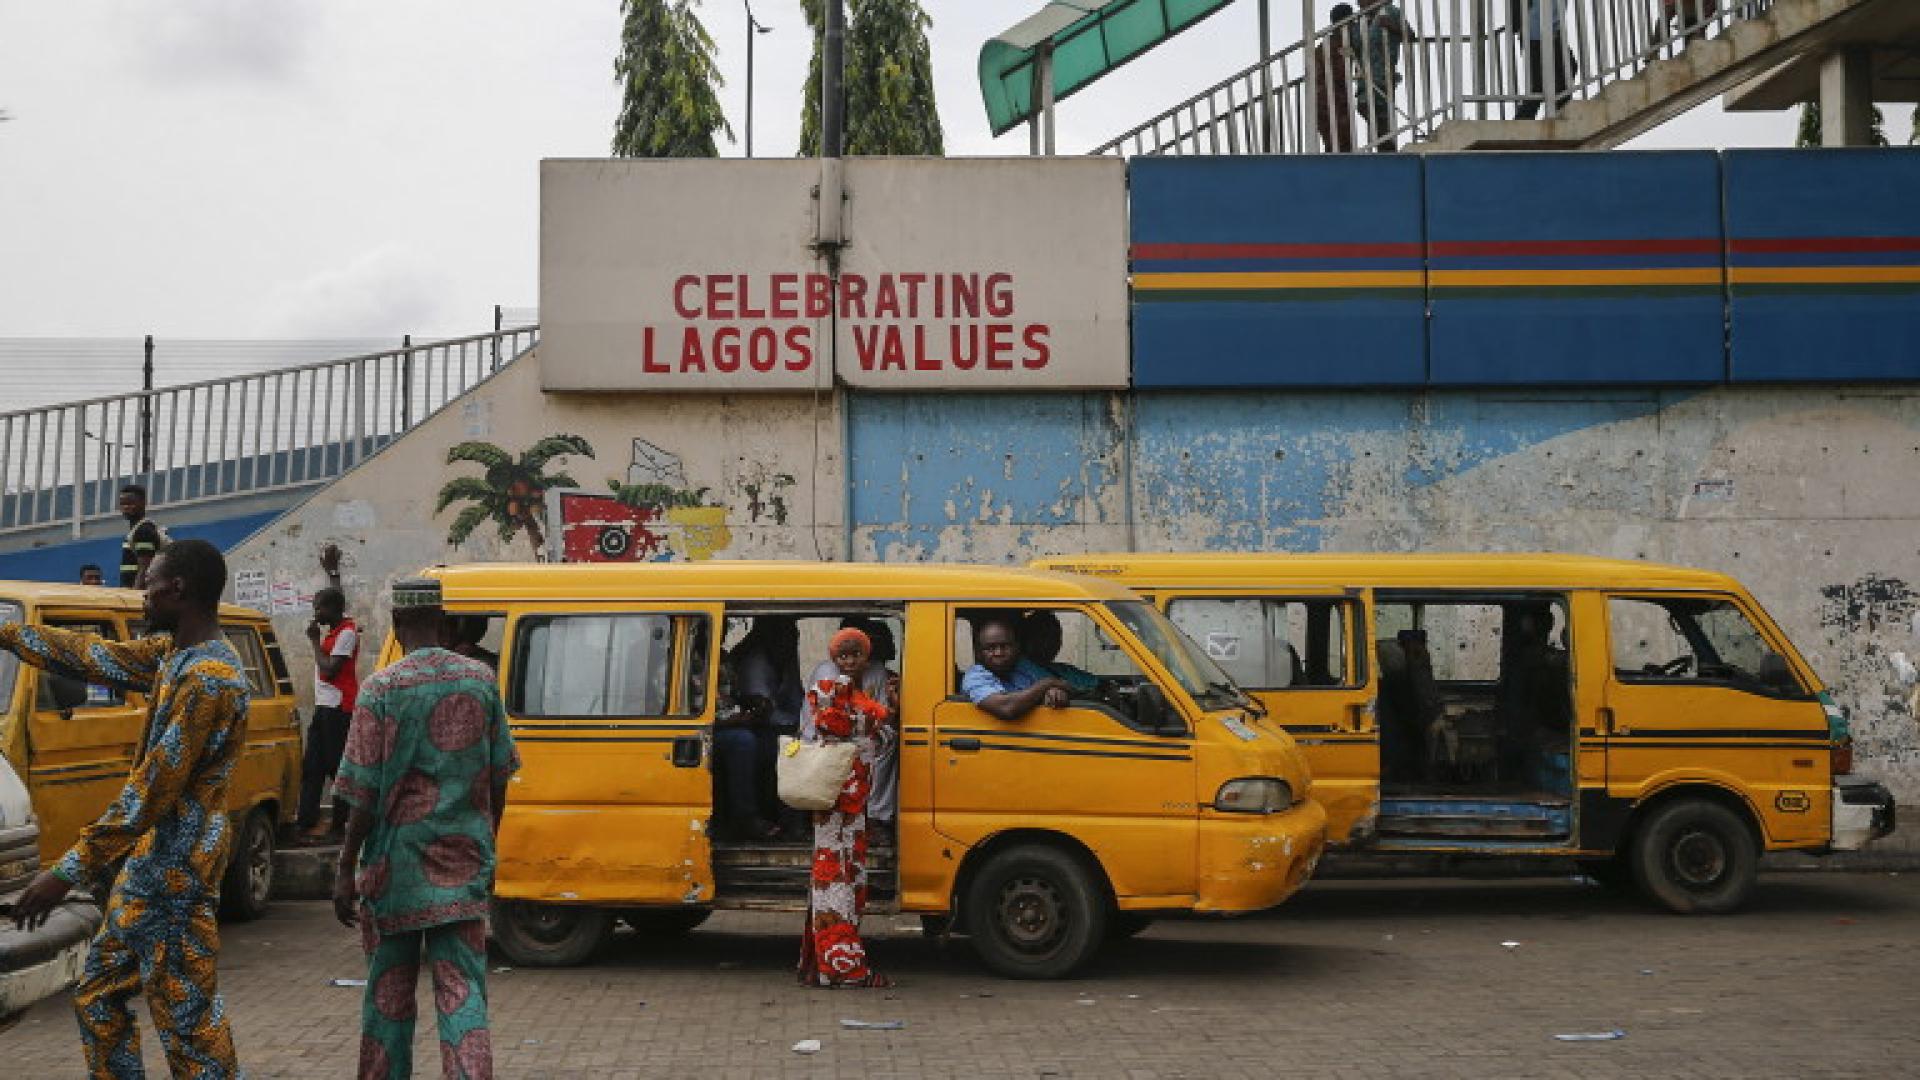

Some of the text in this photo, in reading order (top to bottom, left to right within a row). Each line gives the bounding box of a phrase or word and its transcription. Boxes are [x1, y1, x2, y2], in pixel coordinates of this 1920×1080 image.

[673, 273, 1013, 320] CELEBRATING
[643, 323, 1050, 373] LAGOS VALUES
